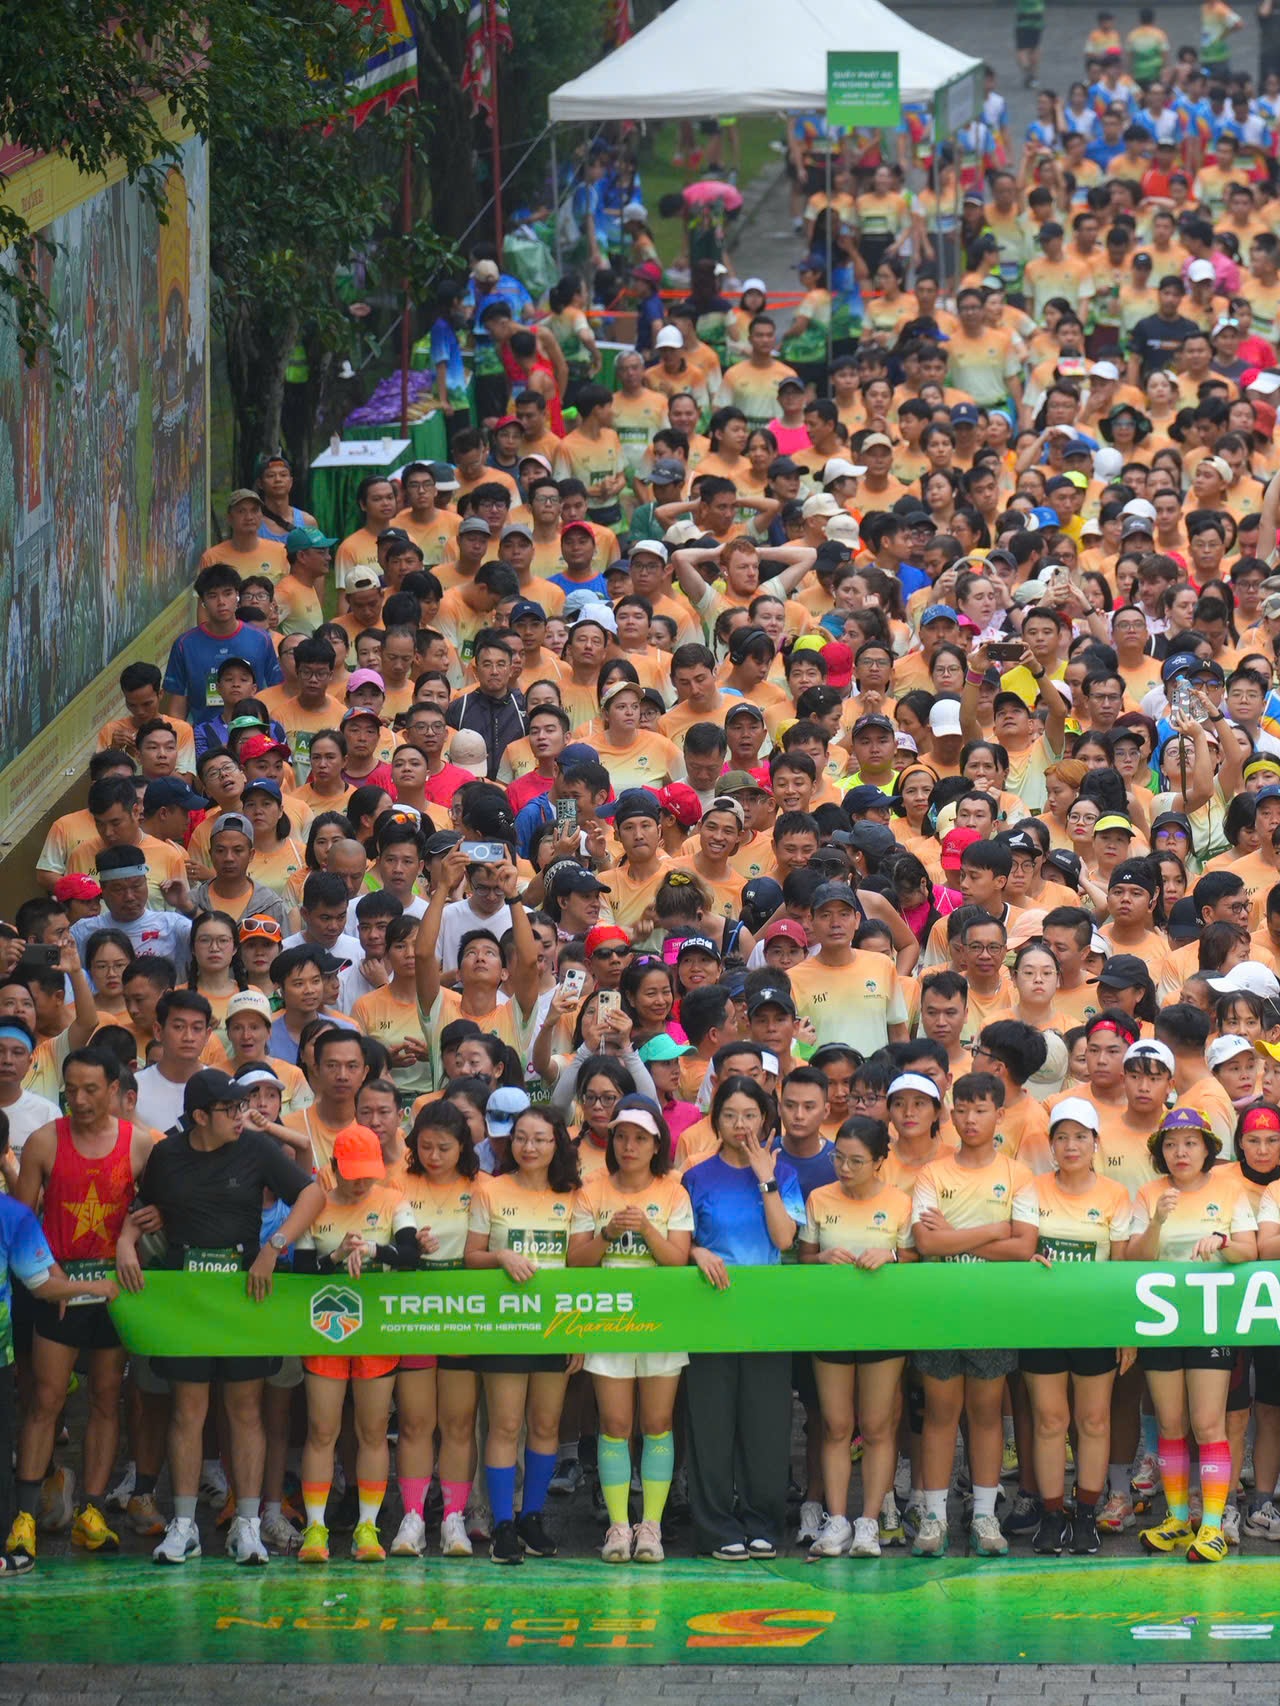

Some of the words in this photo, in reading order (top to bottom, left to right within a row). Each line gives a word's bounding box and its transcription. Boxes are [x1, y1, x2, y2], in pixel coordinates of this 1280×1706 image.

[513, 1240, 563, 1255] B10222
[188, 1260, 239, 1273] B10849
[379, 1295, 486, 1315] TRANG
[499, 1294, 541, 1313] AN
[555, 1293, 634, 1313] 2025
[380, 1322, 441, 1332] FOOTSTRIKE
[443, 1322, 471, 1332] FROM
[474, 1322, 493, 1332] THE
[495, 1322, 542, 1332] HERITAGE
[543, 1308, 663, 1339] Marathon
[214, 1616, 658, 1632] EDITION
[686, 1608, 837, 1648] 5
[505, 1634, 655, 1648] TH
